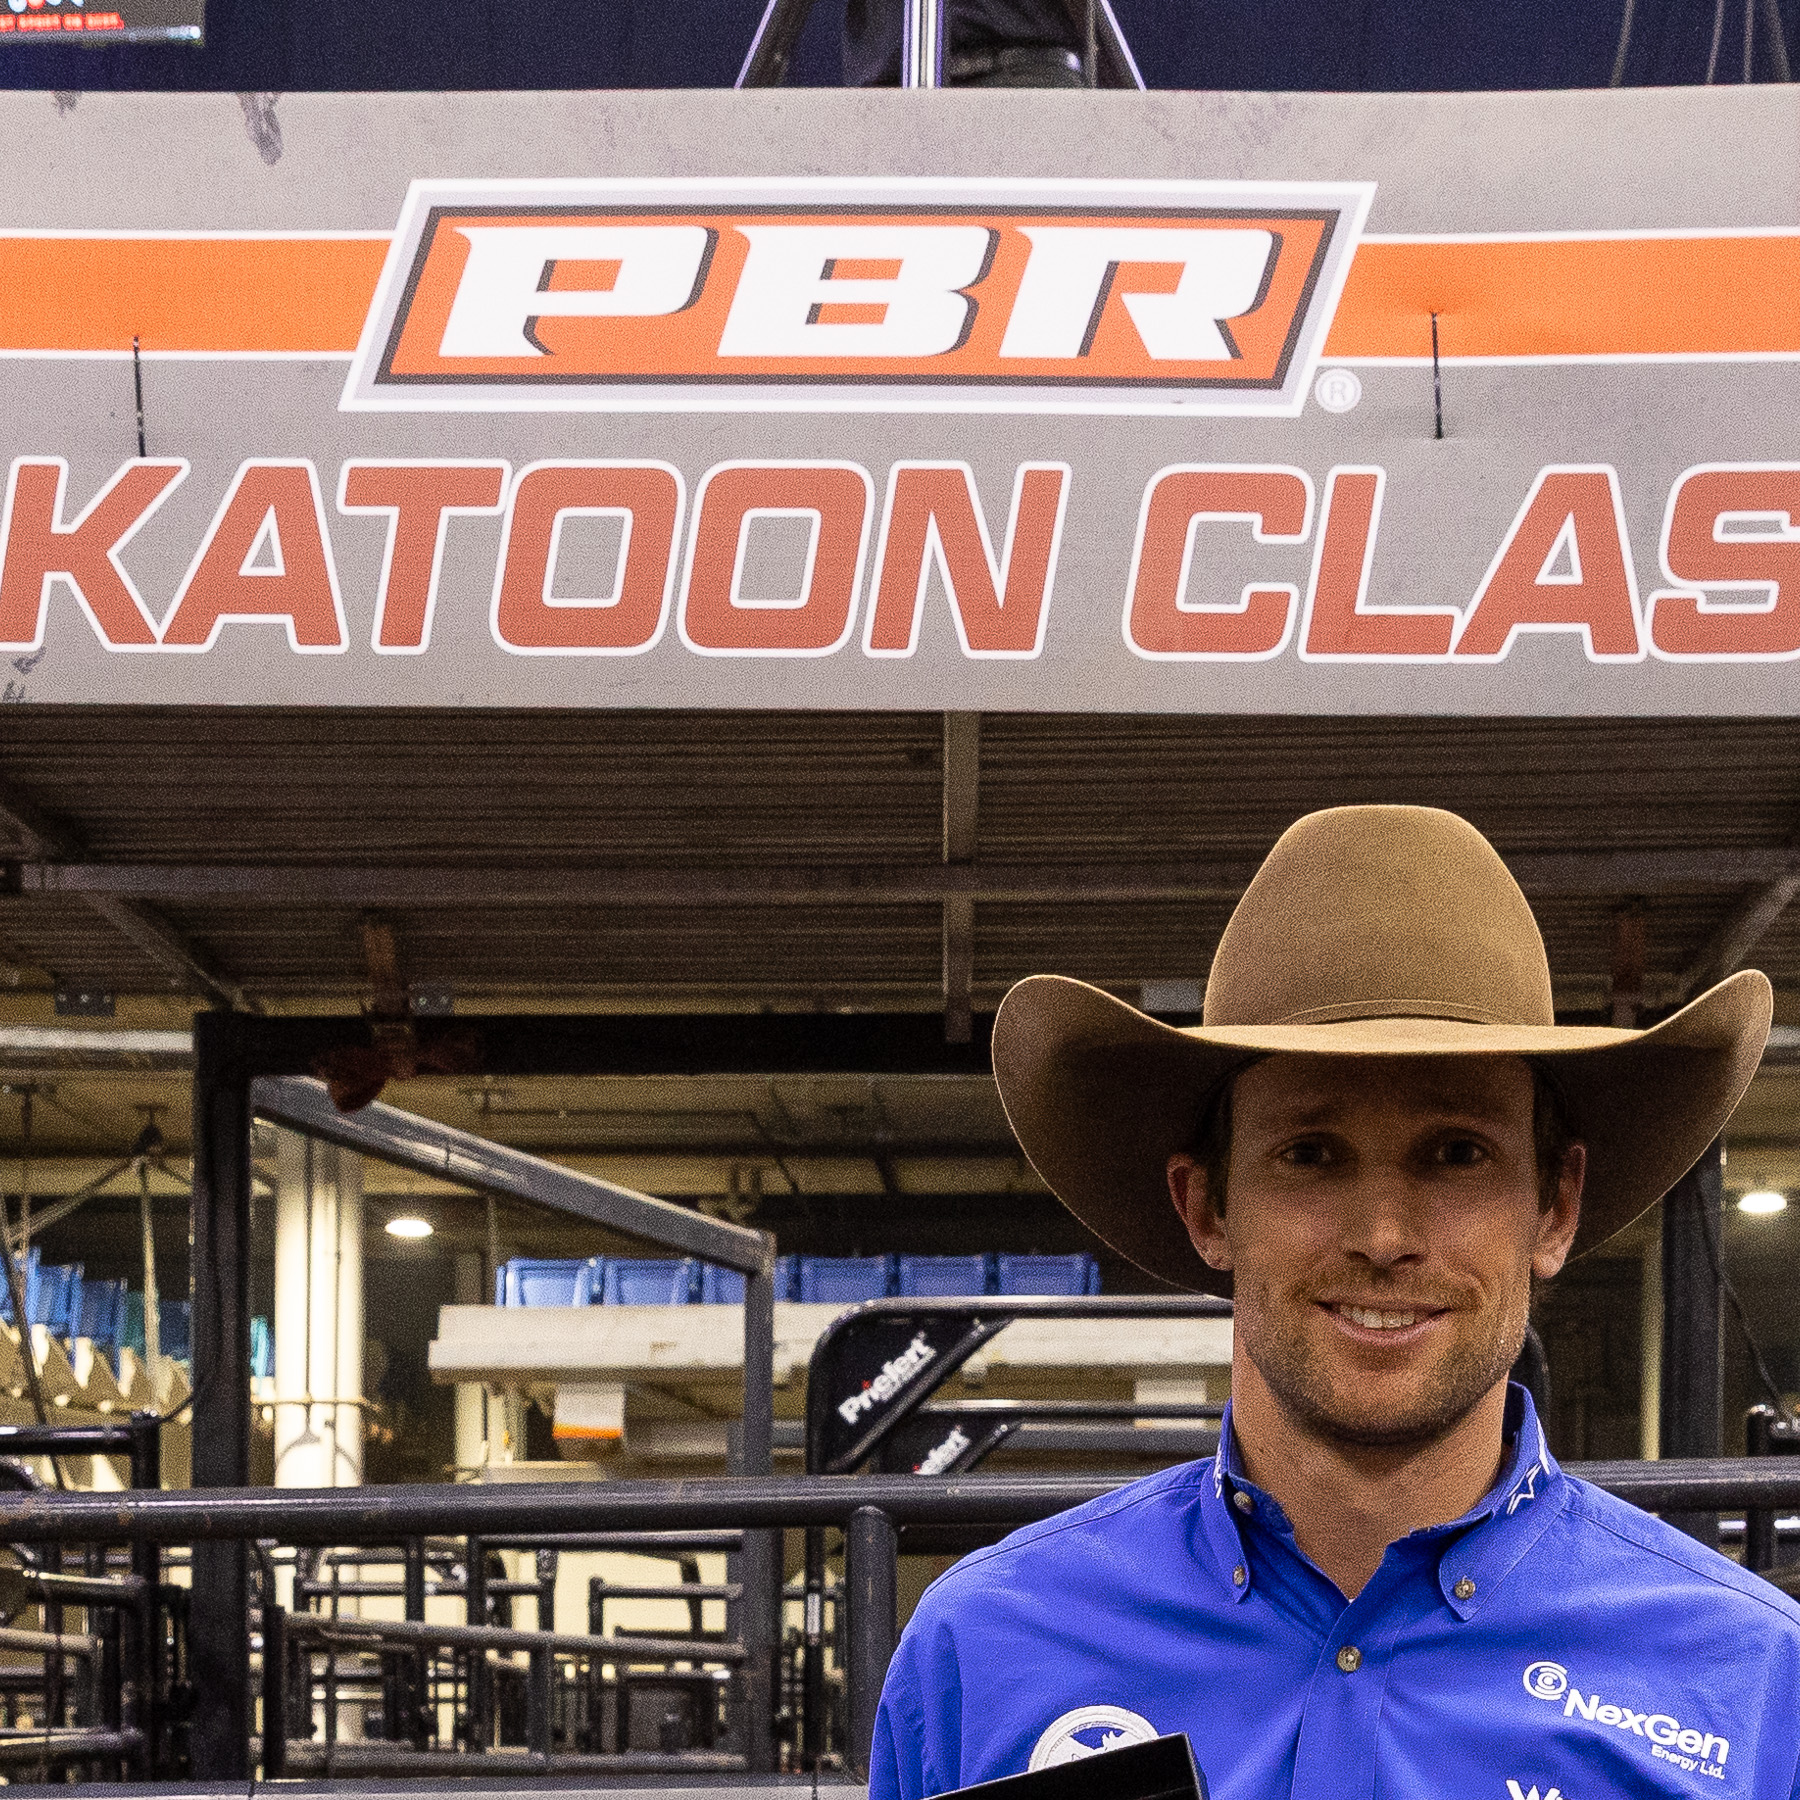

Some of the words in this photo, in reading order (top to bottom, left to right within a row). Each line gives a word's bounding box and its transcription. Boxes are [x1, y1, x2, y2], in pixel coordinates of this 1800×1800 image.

[438, 222, 1283, 361] PBR
[1562, 1688, 1730, 1765] NexGen
[1651, 1743, 1700, 1772] Energy
